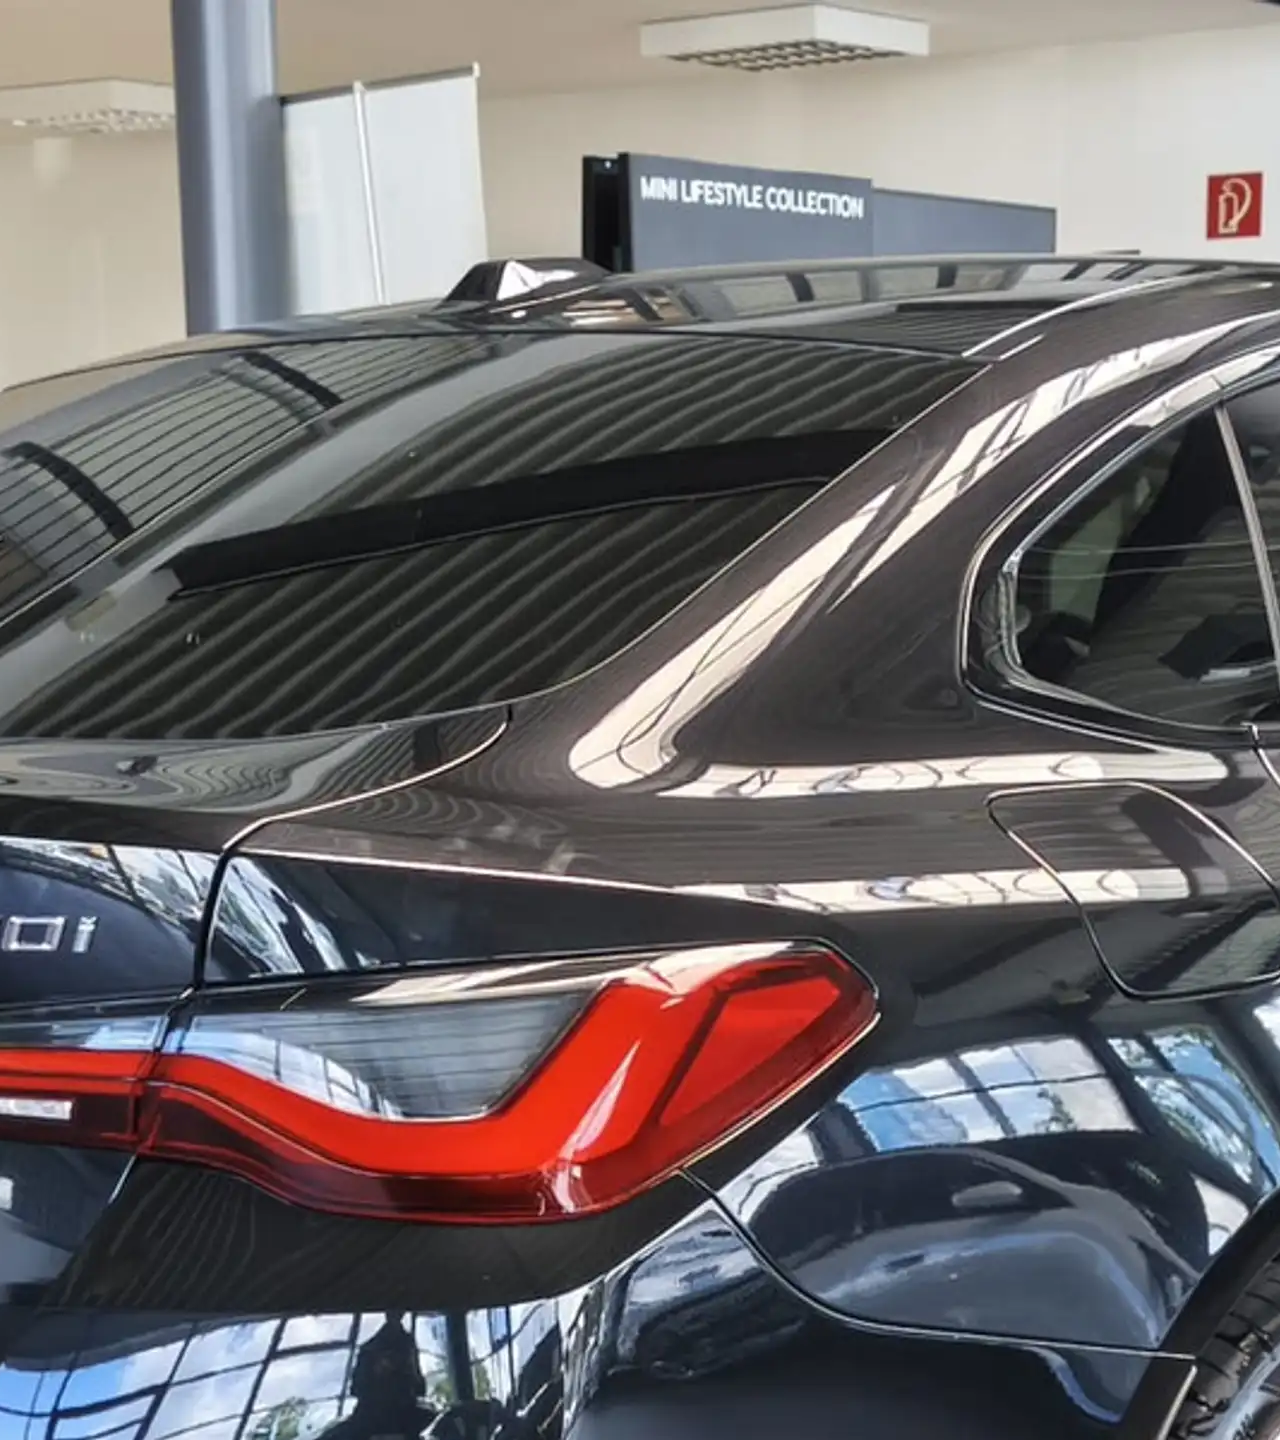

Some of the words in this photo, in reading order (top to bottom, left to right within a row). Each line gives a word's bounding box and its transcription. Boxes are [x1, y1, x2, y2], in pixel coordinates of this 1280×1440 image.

[639, 175, 679, 202] MINI
[680, 180, 763, 209] LIFESTYLE
[765, 187, 865, 220] COLLECTION
